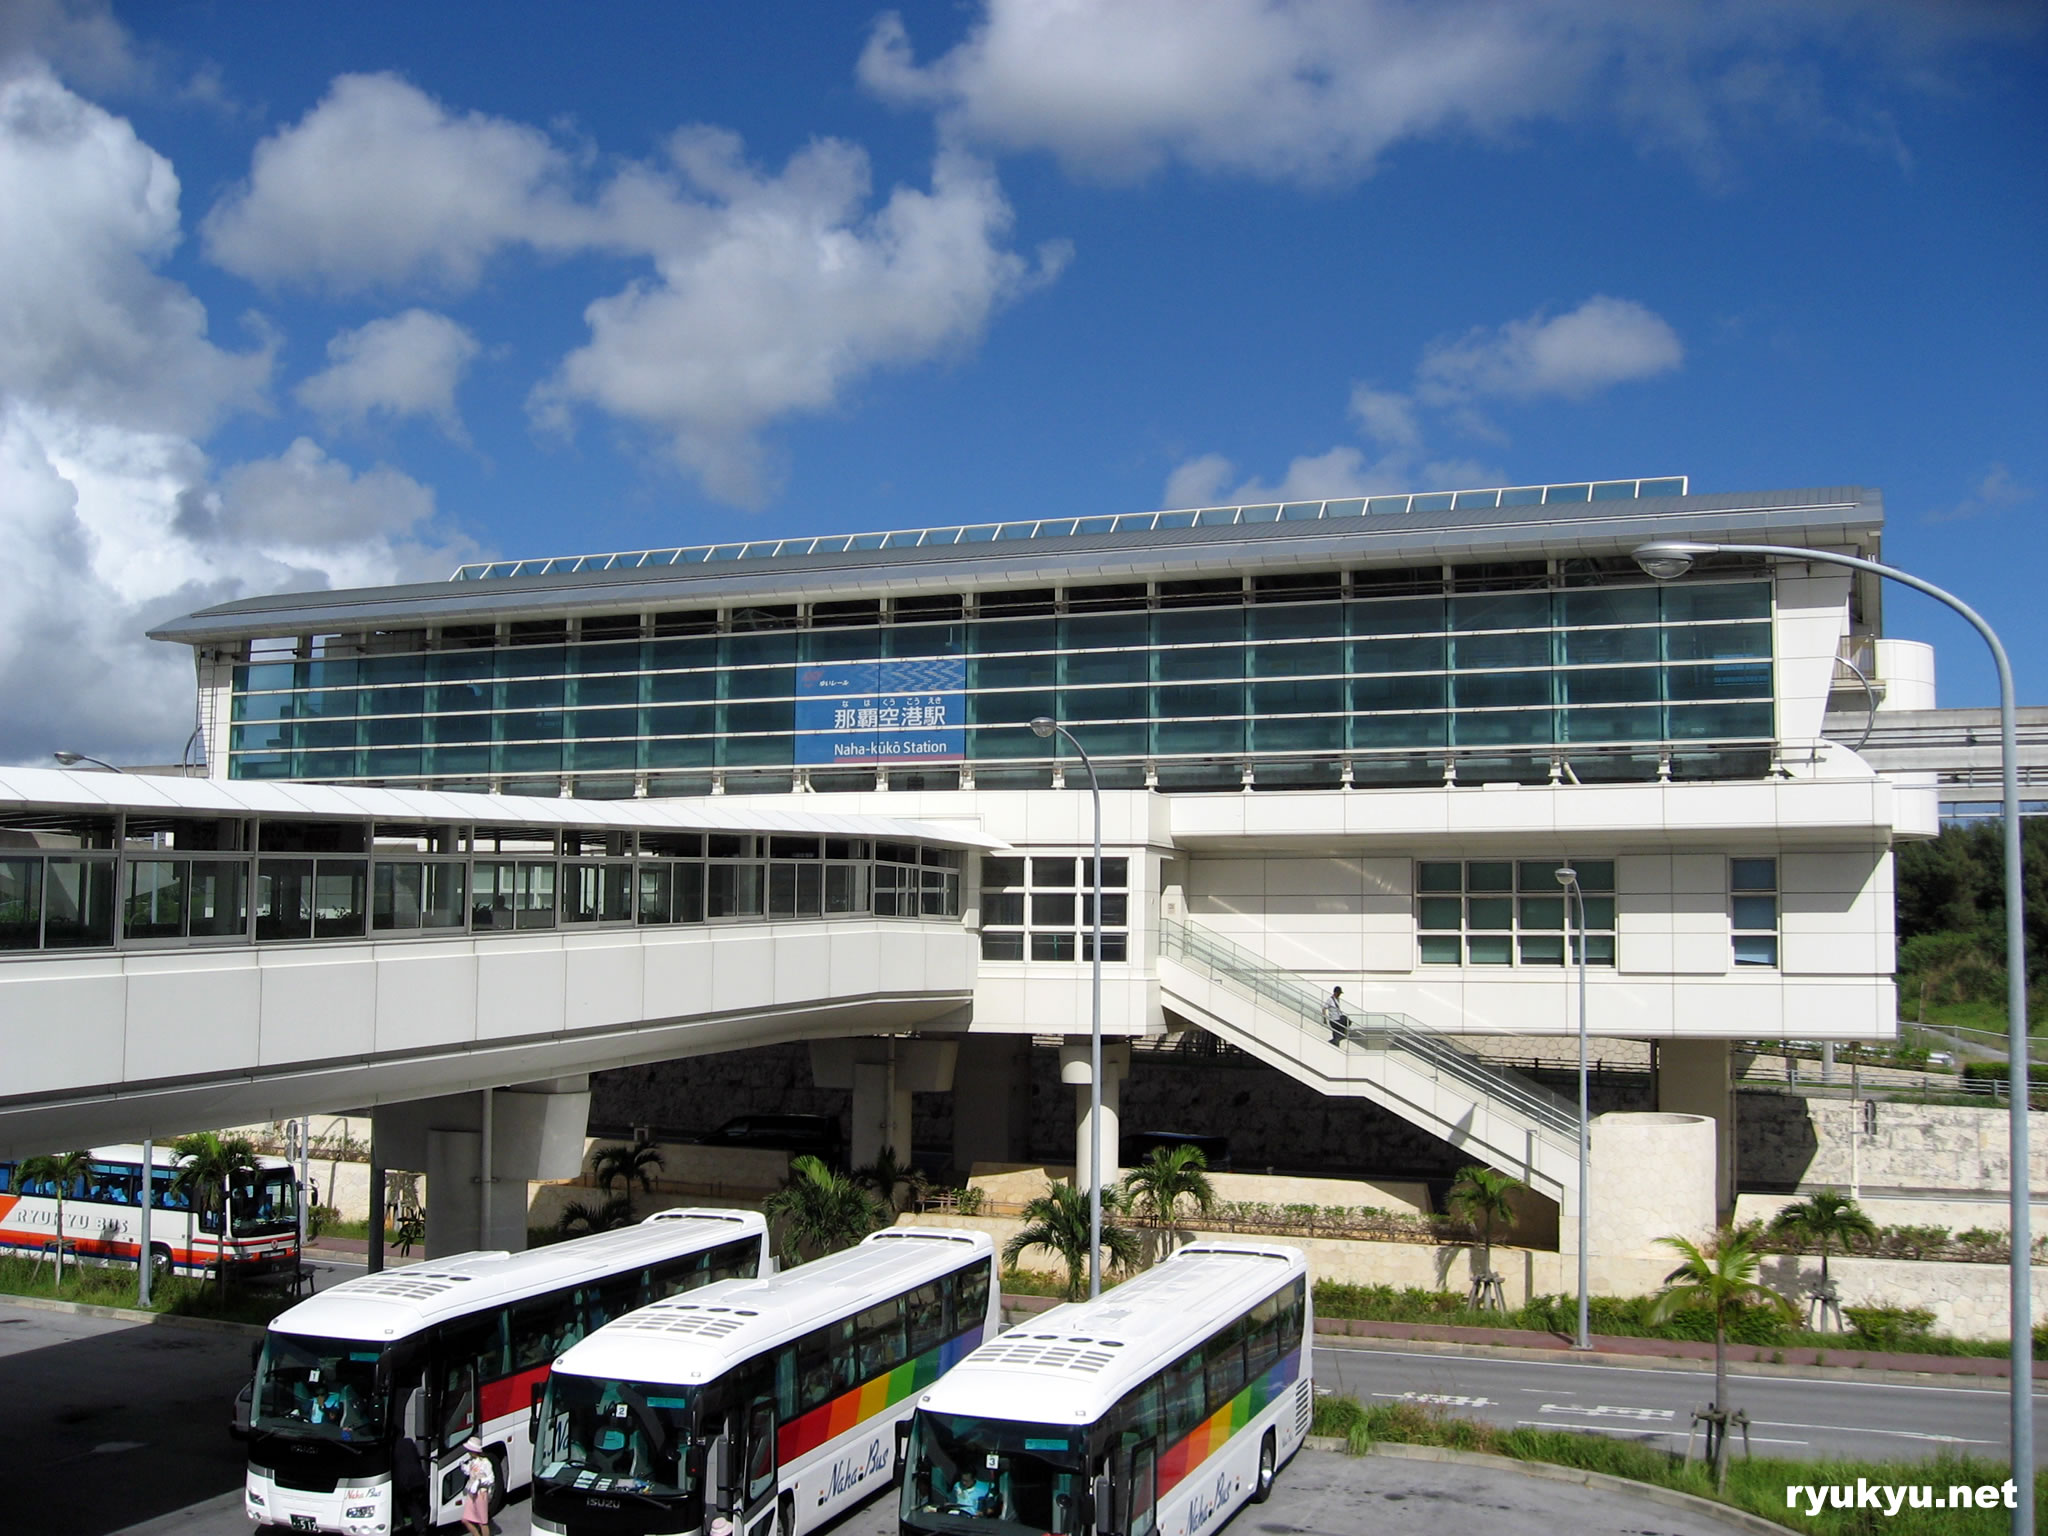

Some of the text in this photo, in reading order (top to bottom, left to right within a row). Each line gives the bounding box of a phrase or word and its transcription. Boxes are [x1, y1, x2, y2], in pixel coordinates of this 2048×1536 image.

[882, 697, 896, 706] くう
[906, 696, 920, 705] こう
[834, 705, 946, 729] 那覇空港駅
[834, 740, 947, 756] Naha-kūkō Station
[97, 1217, 128, 1233] BUS
[824, 1438, 889, 1503] Naha Bus
[1213, 1471, 1232, 1514] Bus
[586, 1497, 621, 1509] ISUZU
